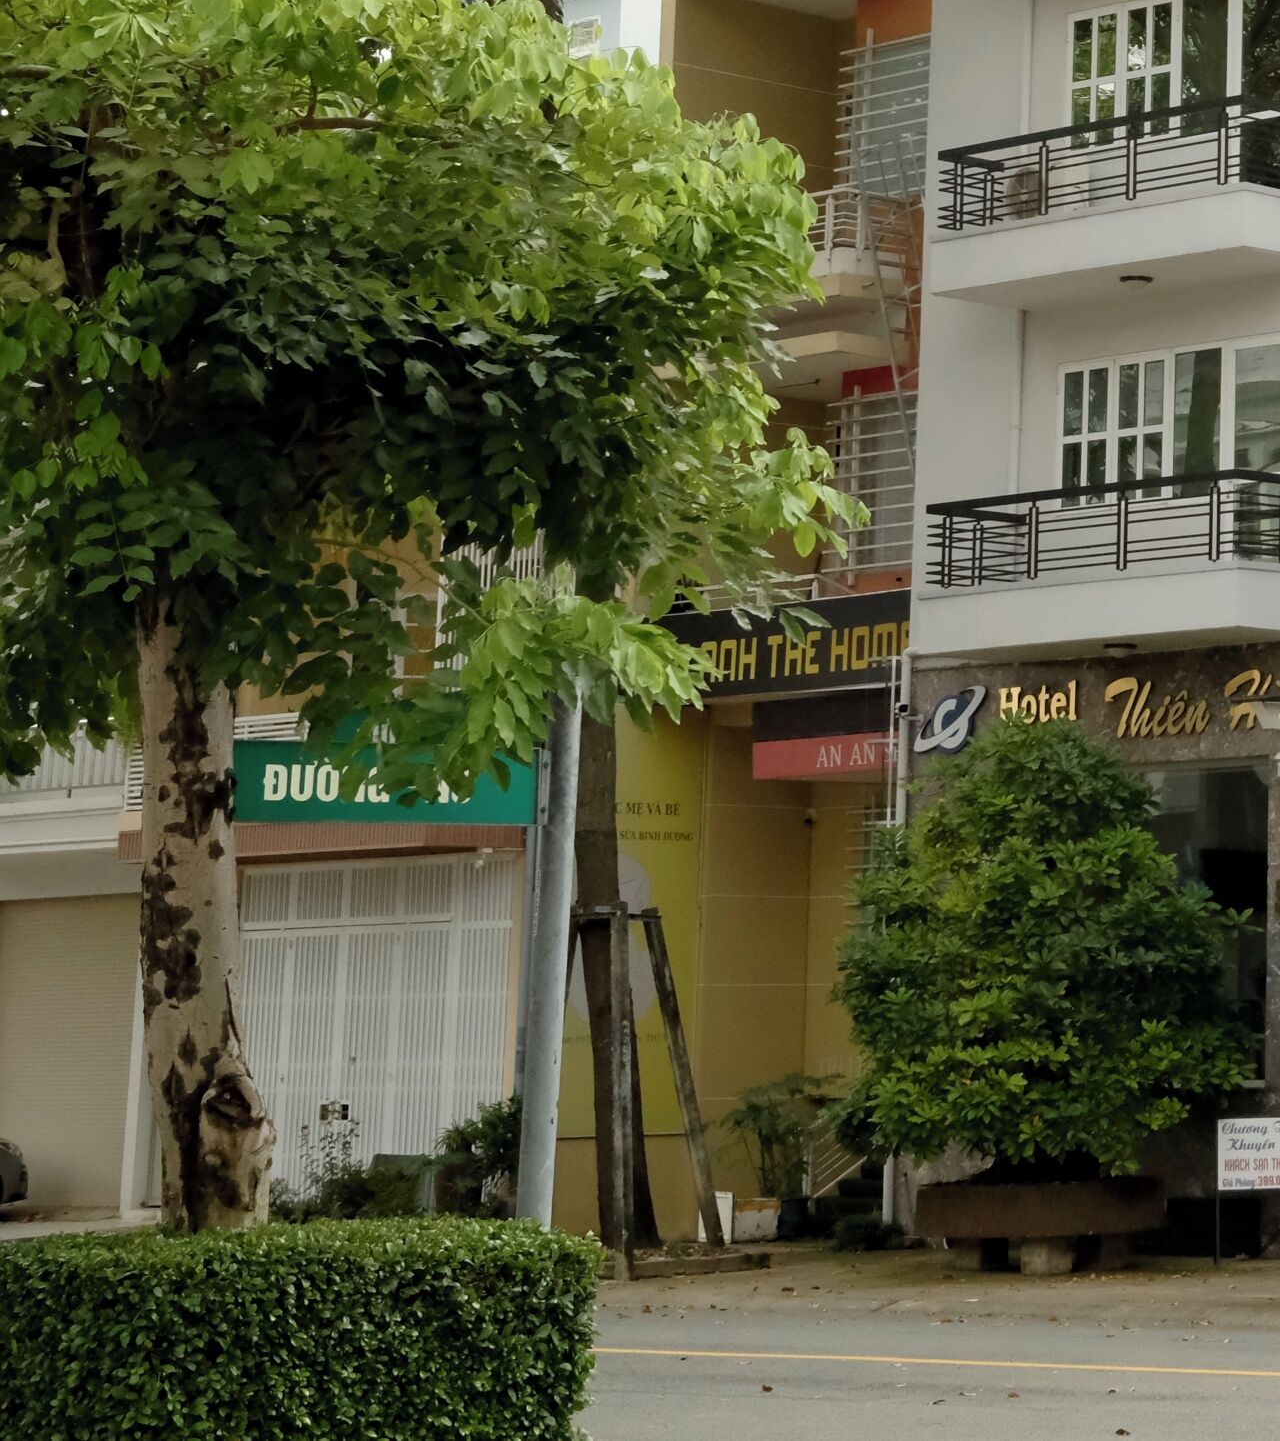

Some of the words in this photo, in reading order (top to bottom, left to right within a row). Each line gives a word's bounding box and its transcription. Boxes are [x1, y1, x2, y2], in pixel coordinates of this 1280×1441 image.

[767, 631, 822, 679] THE
[999, 679, 1078, 725] Hotel
[1104, 676, 1211, 739] Thiên
[816, 744, 842, 768] AN
[849, 742, 876, 766] AN
[1224, 1156, 1250, 1172] KHÁCH
